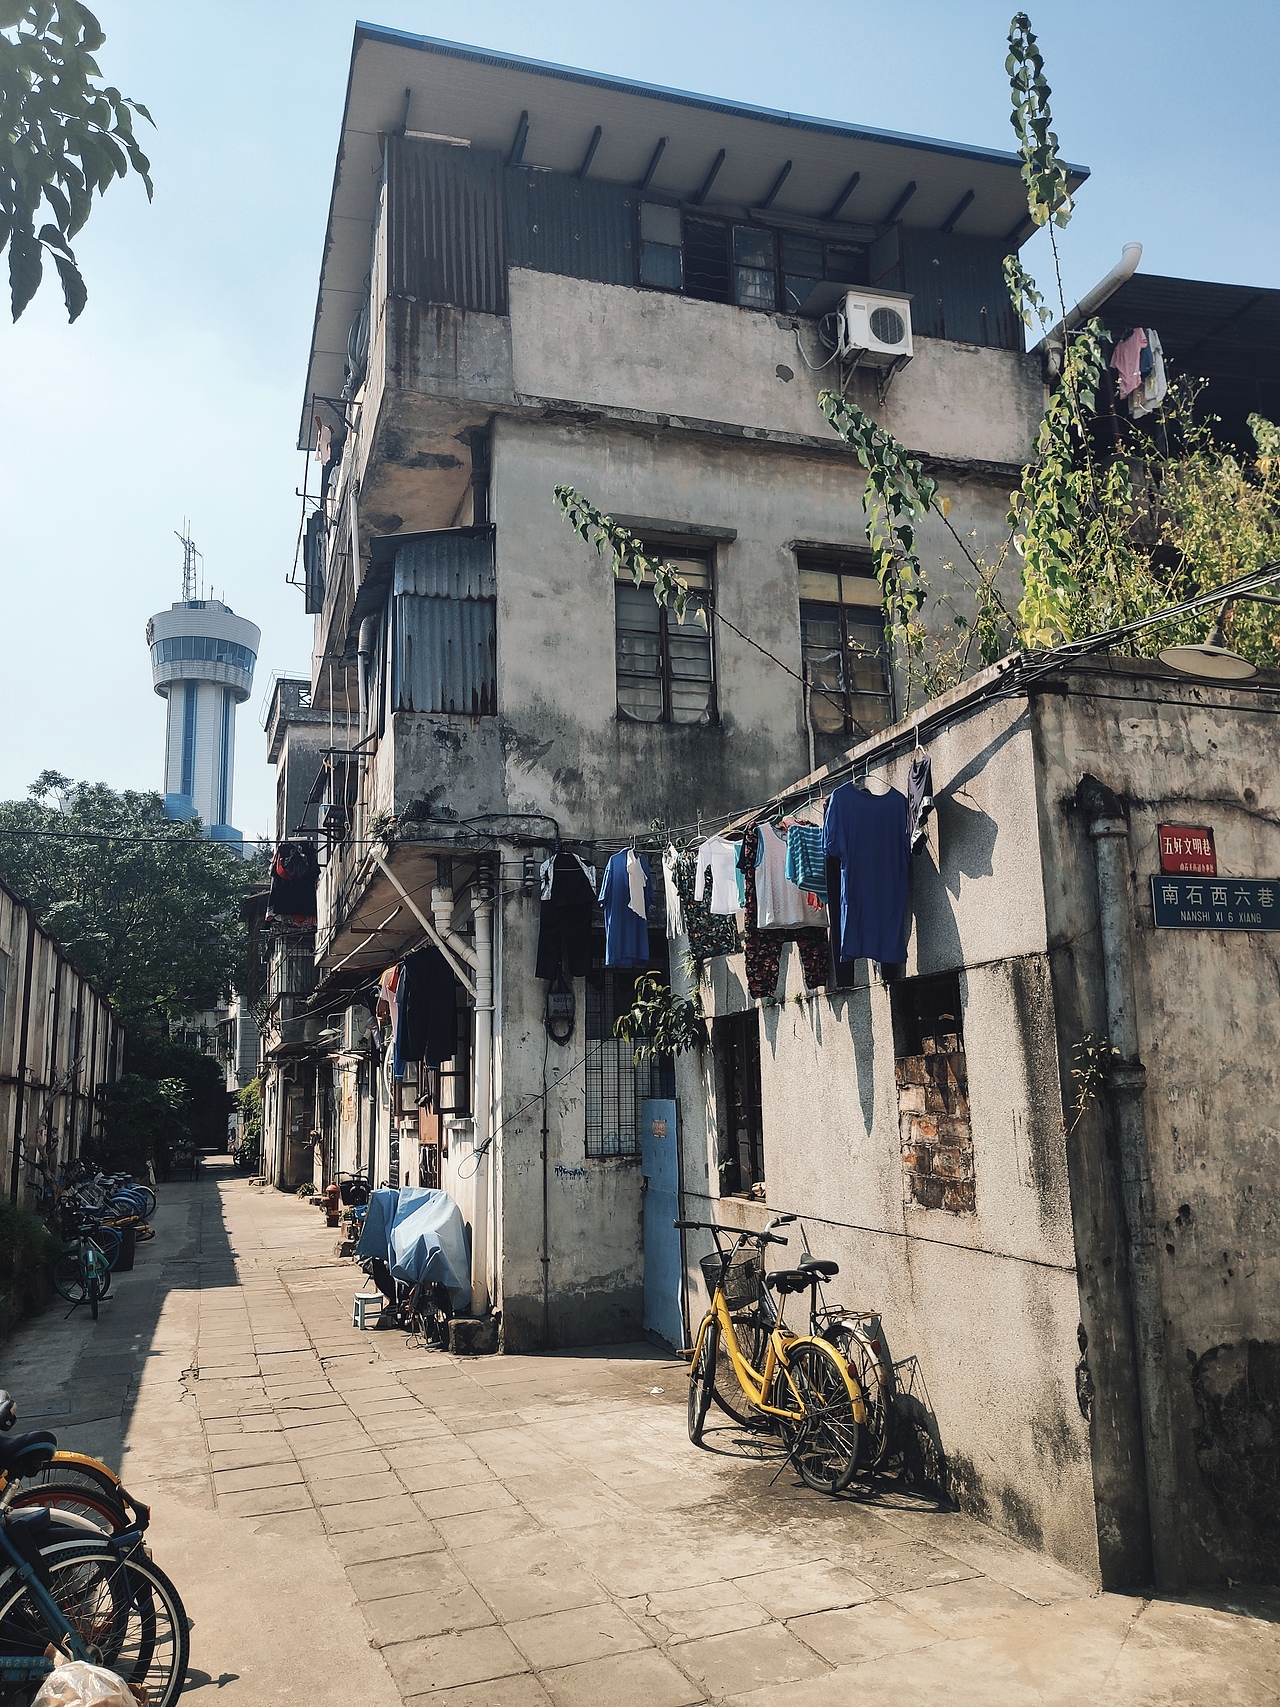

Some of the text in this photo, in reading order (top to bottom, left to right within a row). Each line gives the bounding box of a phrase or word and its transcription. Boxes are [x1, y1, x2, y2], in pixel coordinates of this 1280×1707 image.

[1163, 837, 1211, 856] 五好文明巷
[1161, 883, 1274, 908] 南石西六巷
[1180, 910, 1262, 924] NANSHI XI 6 XIANG
